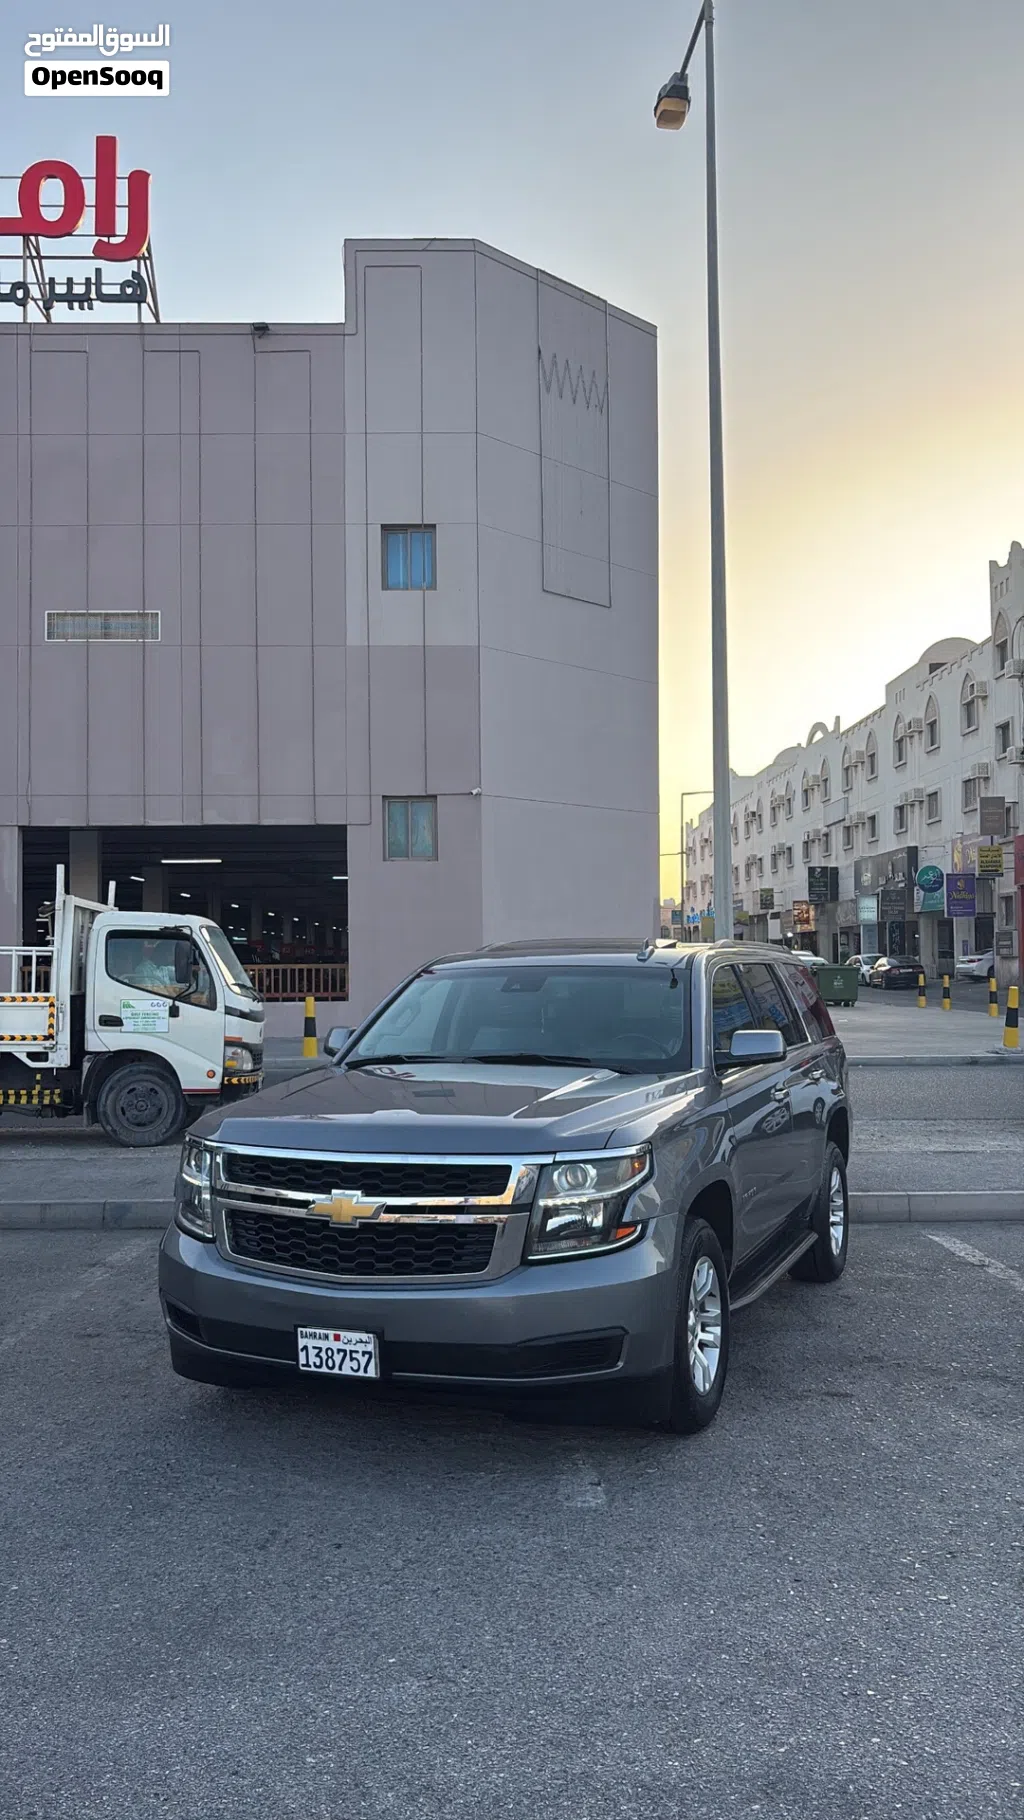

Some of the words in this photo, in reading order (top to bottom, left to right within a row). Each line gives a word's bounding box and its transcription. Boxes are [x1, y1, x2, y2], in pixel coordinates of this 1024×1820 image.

[0, 135, 151, 262] رام
[43, 268, 148, 310] هايبر
[300, 1330, 330, 1341] BAHRAIN
[342, 1335, 372, 1347] البحرين
[300, 1344, 373, 1374] 138757
